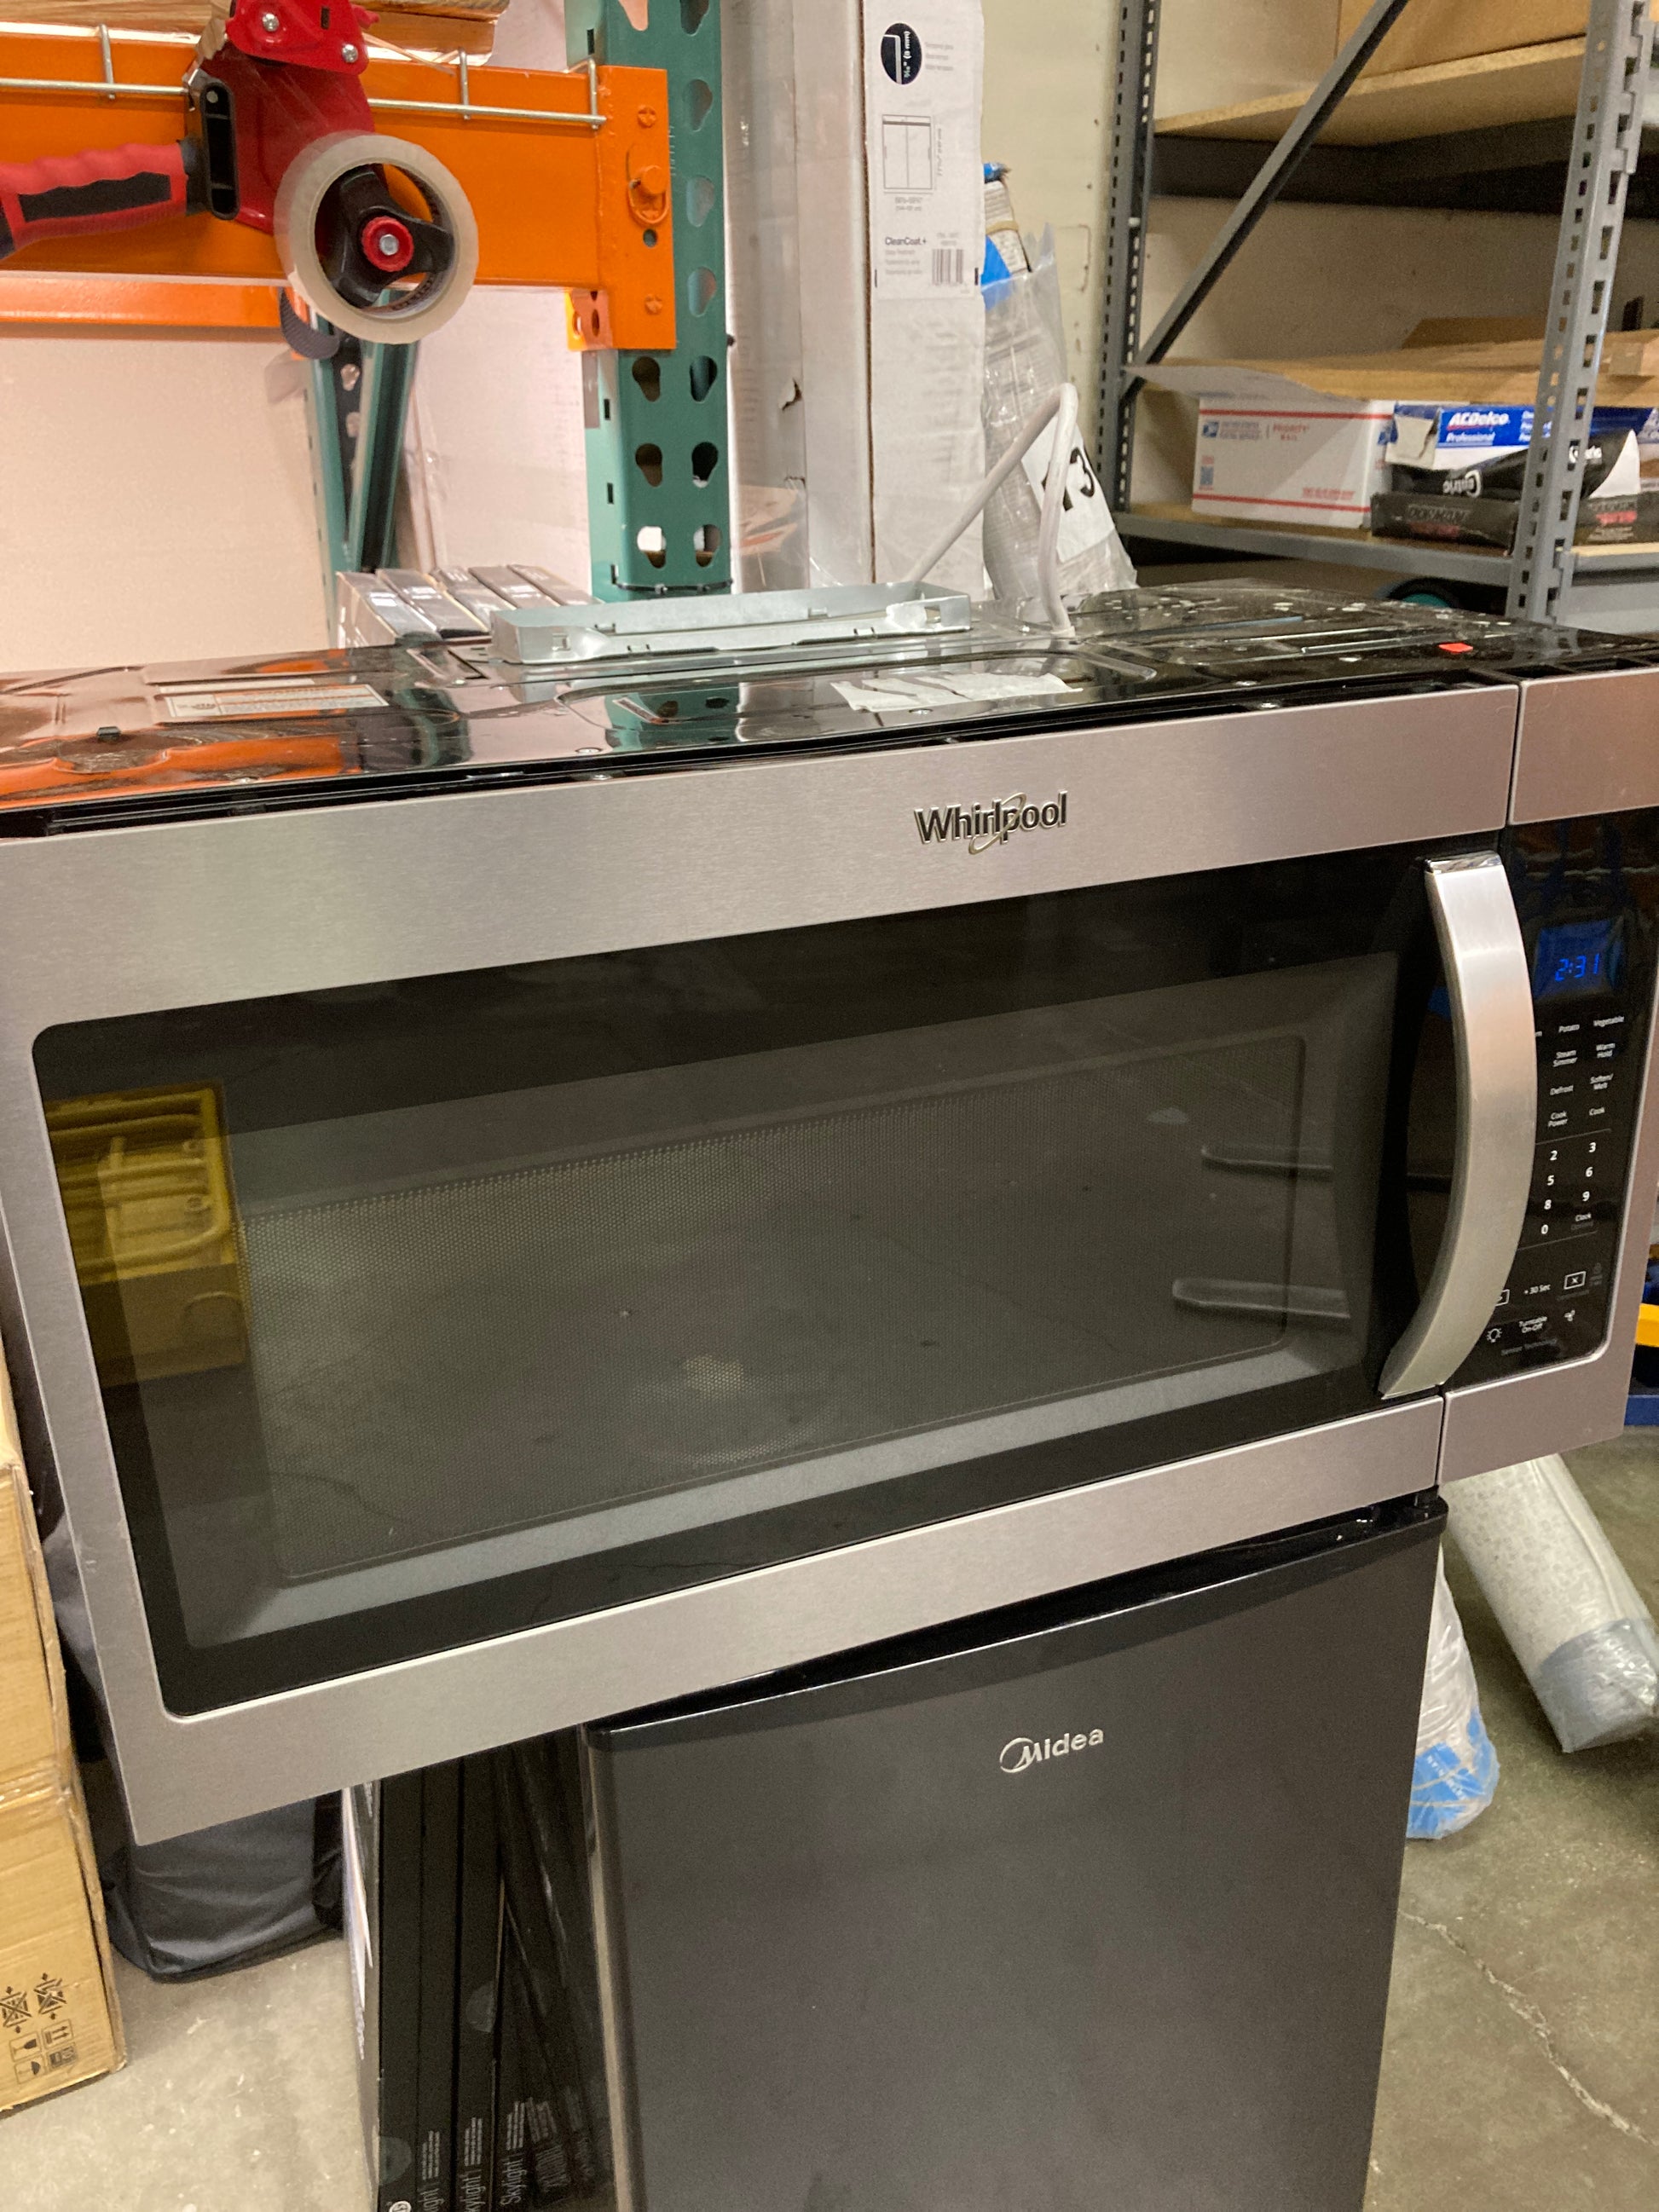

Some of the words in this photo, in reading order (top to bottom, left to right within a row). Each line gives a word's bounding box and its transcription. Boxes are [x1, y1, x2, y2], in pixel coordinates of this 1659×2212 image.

[1448, 411, 1511, 426] ACDelco
[914, 789, 1068, 854] Whirlpool
[1555, 954, 1599, 981] 2:31
[1588, 1141, 1597, 1152] 3
[1549, 1150, 1558, 1161] 2
[1585, 1166, 1593, 1177] 6
[1546, 1175, 1555, 1186] 5
[1582, 1191, 1590, 1202] 9
[1543, 1199, 1552, 1210] 8
[1540, 1224, 1549, 1235] 0
[999, 1729, 1104, 1773] Midea
